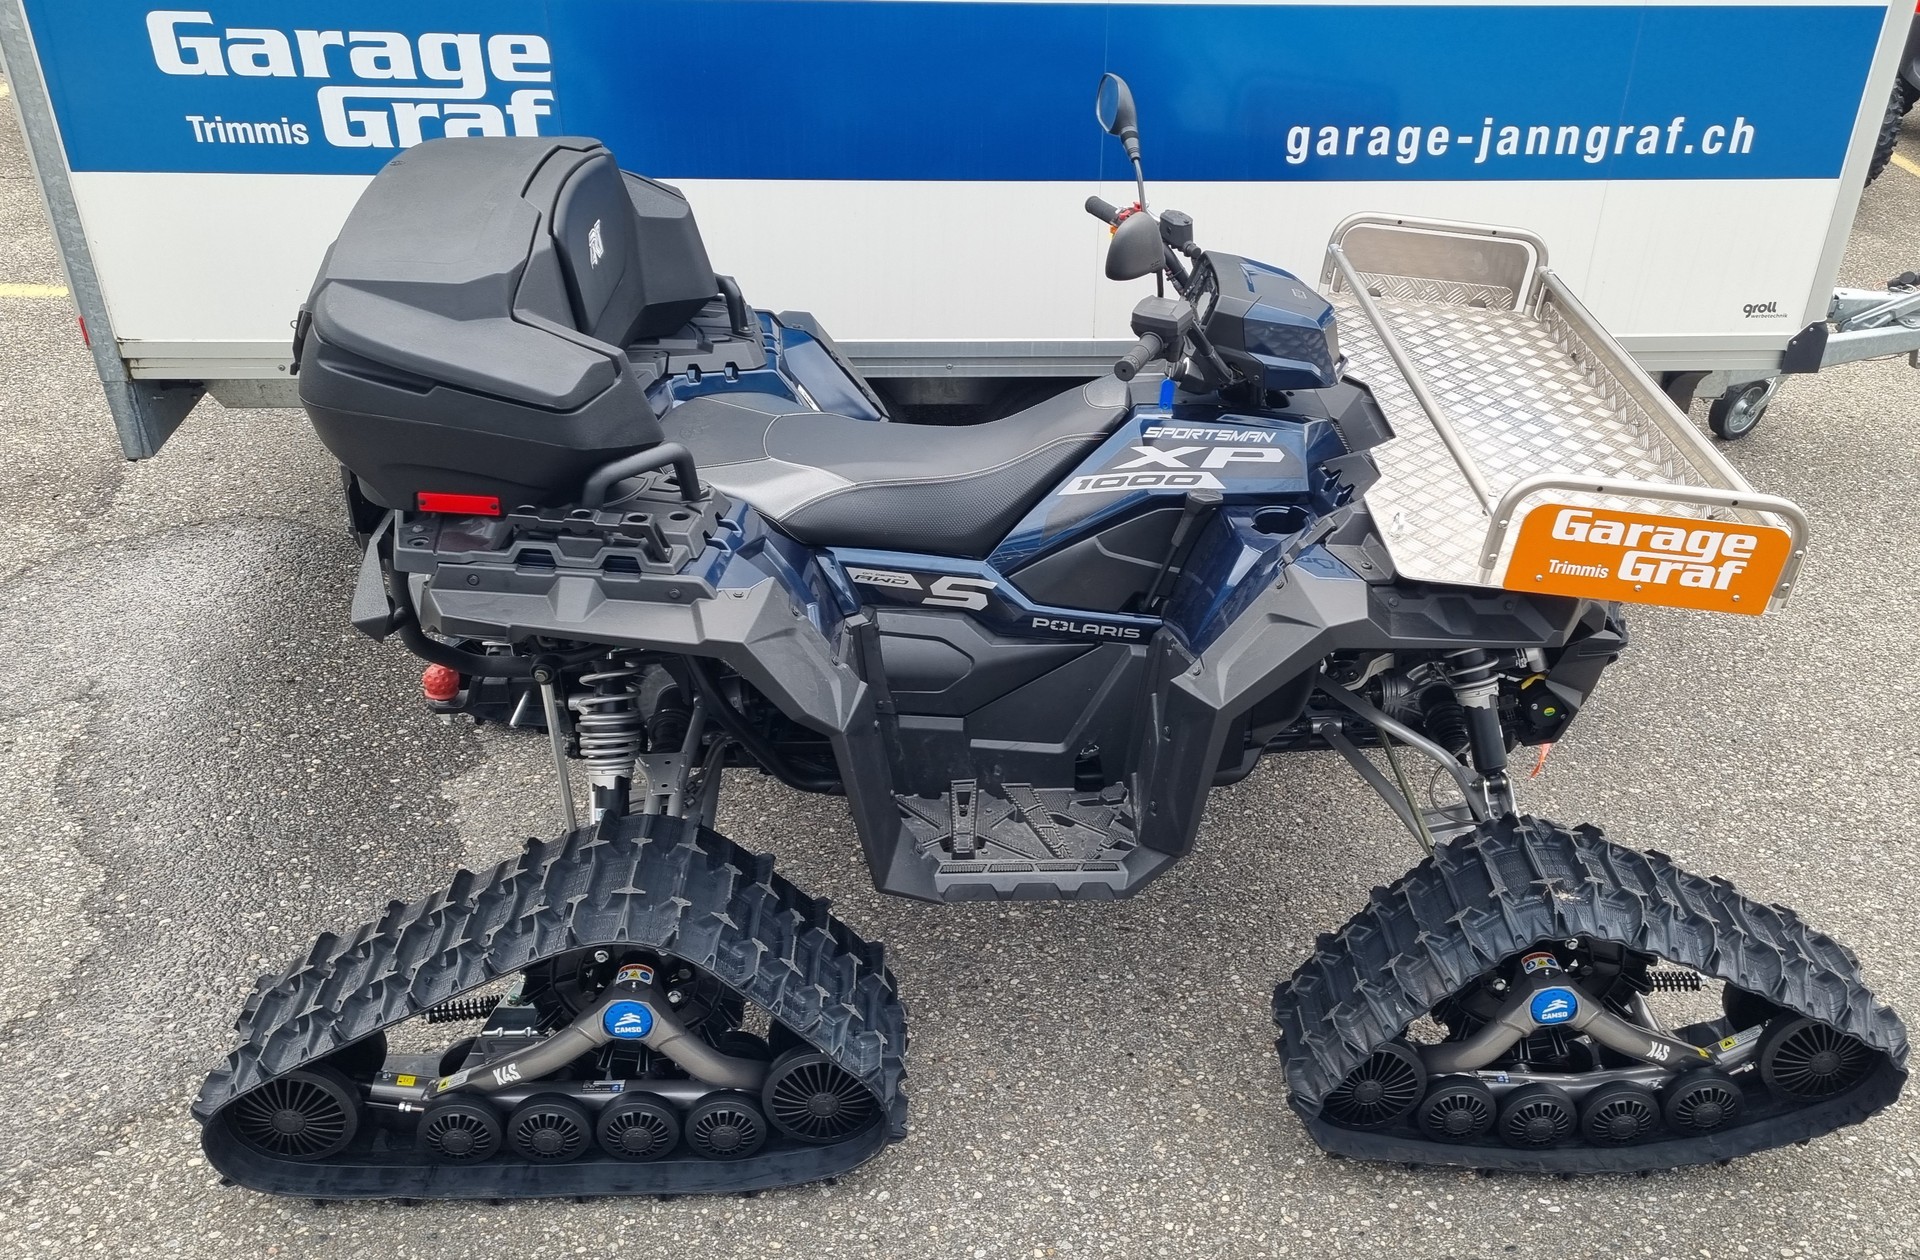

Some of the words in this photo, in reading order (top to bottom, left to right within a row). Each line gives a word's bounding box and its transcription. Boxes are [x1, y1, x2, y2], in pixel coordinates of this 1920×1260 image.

[146, 11, 552, 100] Garage
[185, 116, 310, 146] Trimmis
[317, 86, 554, 148] Graf
[1285, 116, 1756, 164] garage-janngraf.ch
[1743, 301, 1777, 318] groll
[1143, 426, 1277, 443] SPORTSMAN
[1111, 445, 1286, 470] XP
[1077, 474, 1204, 490] 1000
[1551, 508, 1758, 564] Garage
[854, 574, 909, 585] AWD
[1549, 559, 1610, 579] Trimmis
[1617, 550, 1748, 591] Graf
[921, 575, 999, 611] S
[1031, 617, 1141, 639] POLARIS
[1541, 1011, 1568, 1020] CAMSO
[614, 1026, 643, 1034] CAMSO
